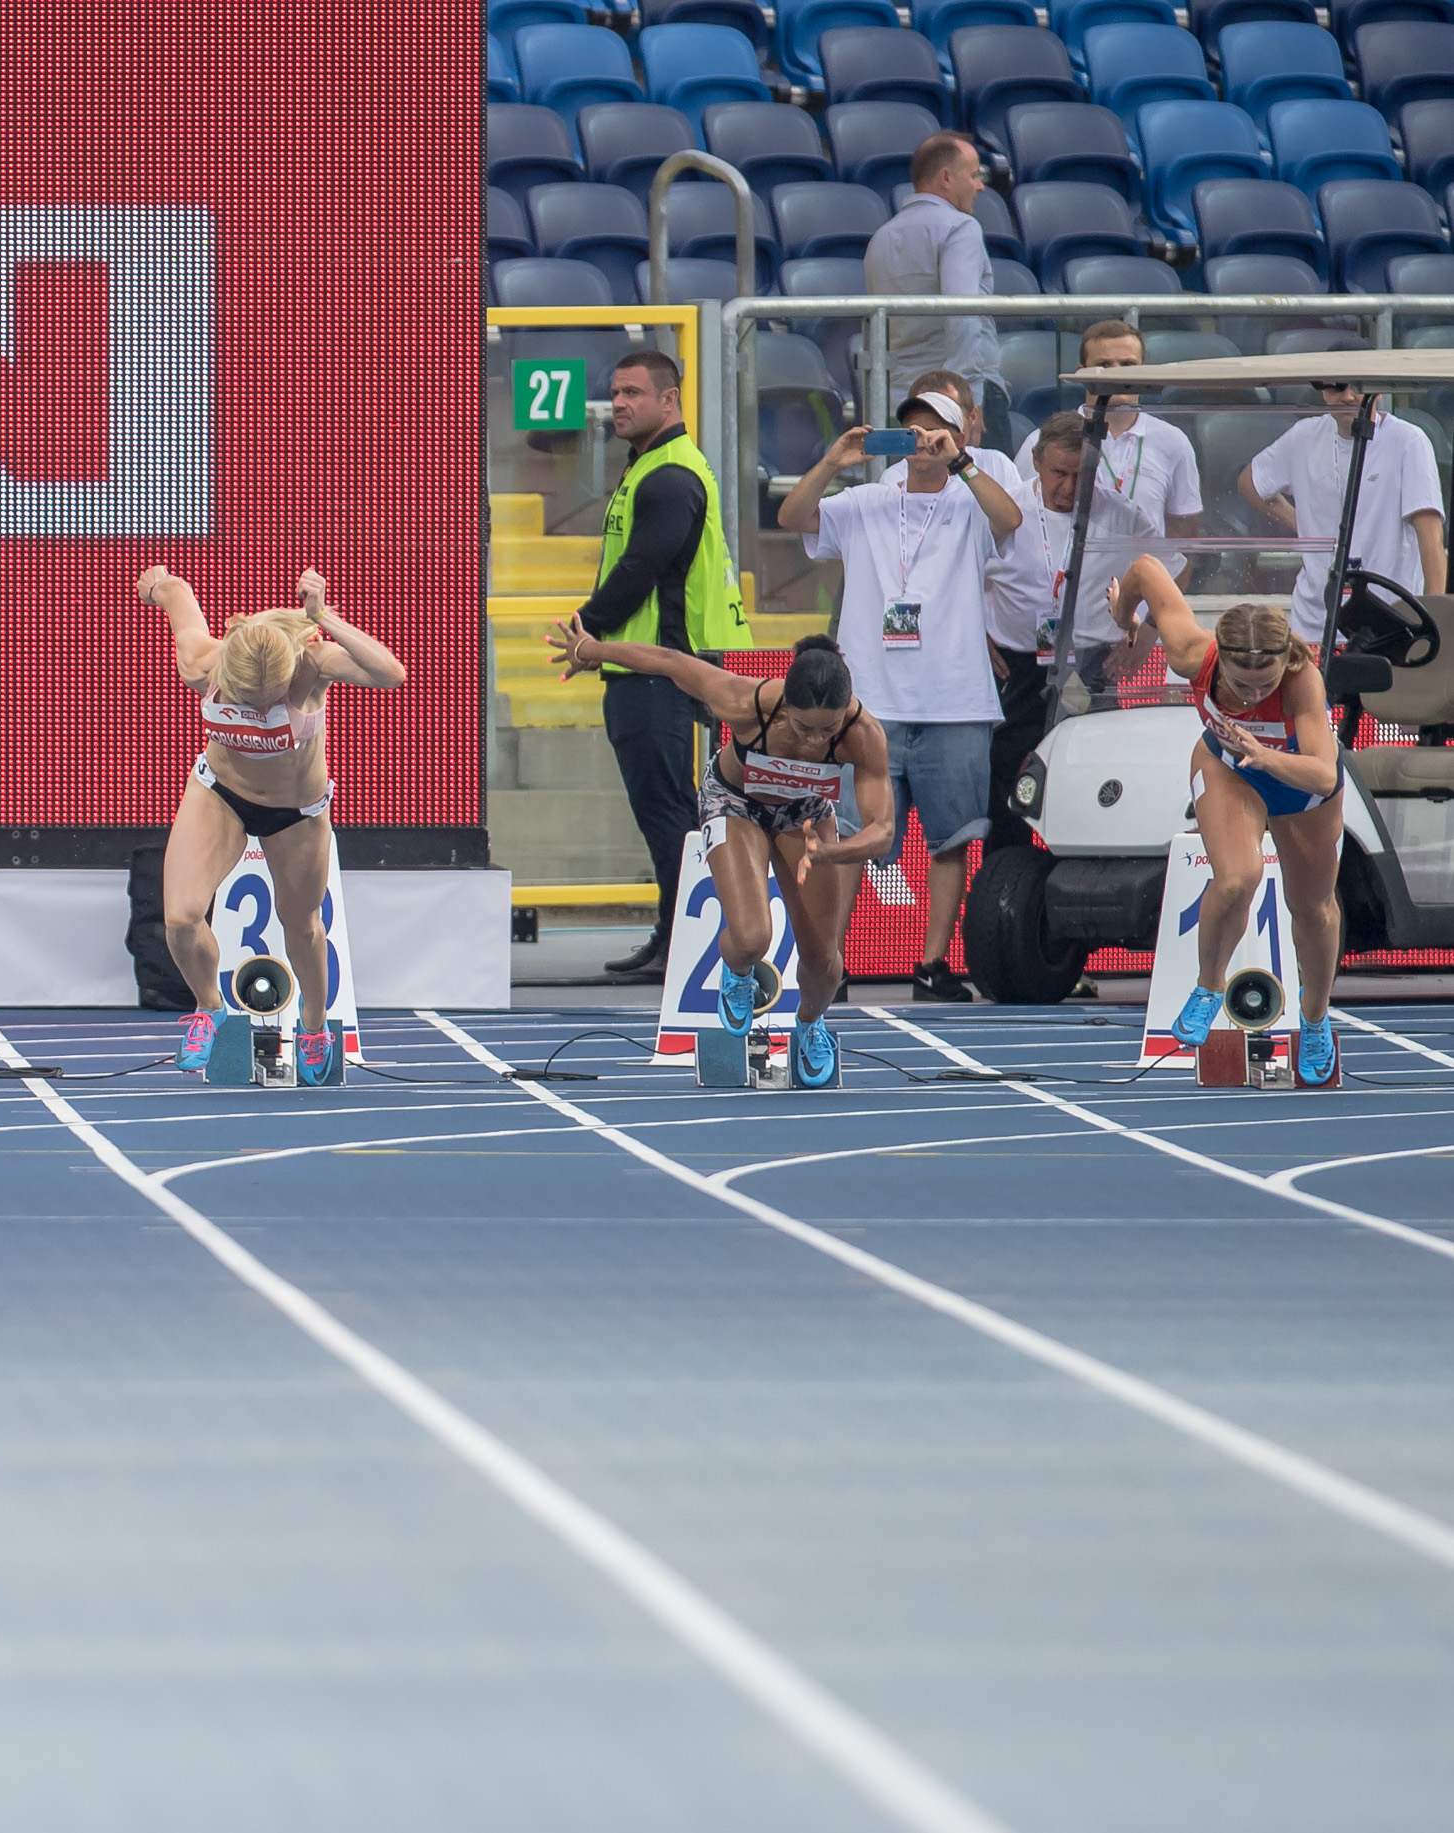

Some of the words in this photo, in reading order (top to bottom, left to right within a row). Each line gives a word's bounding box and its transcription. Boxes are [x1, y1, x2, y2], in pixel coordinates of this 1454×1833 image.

[529, 369, 572, 420] 27
[791, 764, 820, 775] ORLEN
[703, 824, 714, 848] 2
[243, 847, 265, 862] pola
